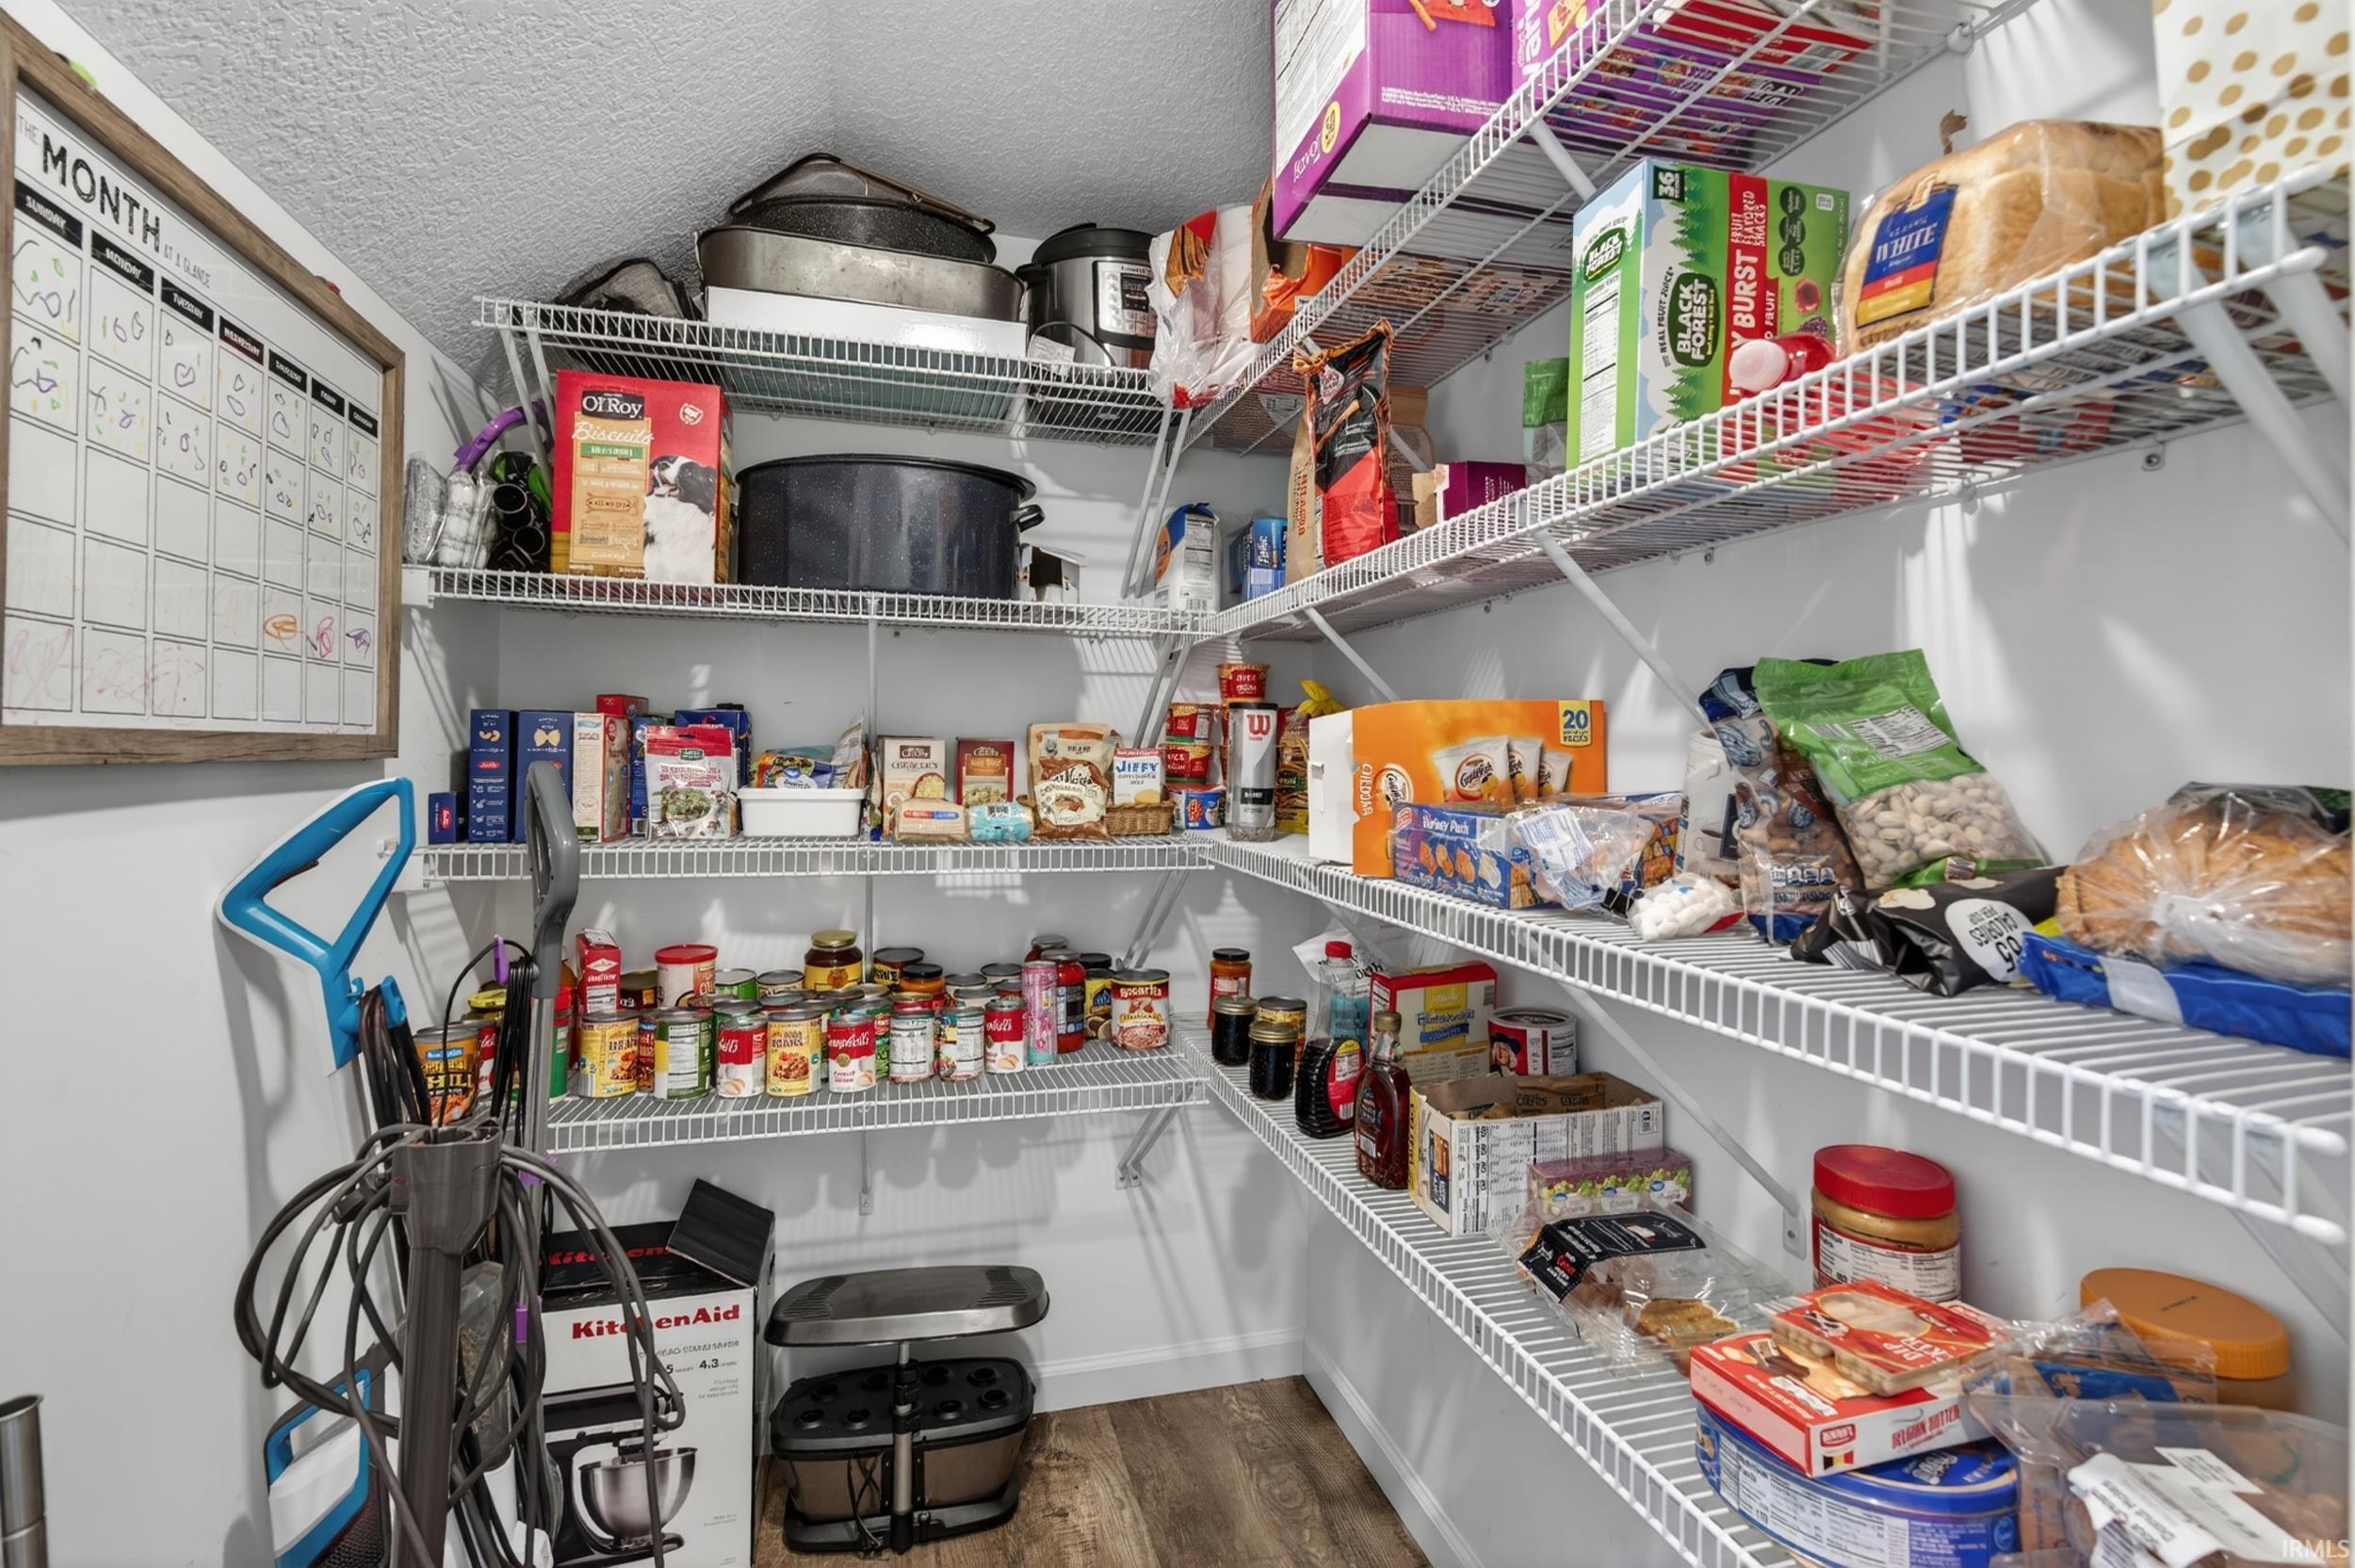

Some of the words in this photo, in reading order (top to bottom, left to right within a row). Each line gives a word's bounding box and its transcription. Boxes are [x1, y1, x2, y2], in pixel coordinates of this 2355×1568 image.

[42, 134, 160, 252] MONTH
[1658, 170, 1676, 197] 36
[25, 194, 68, 230] SUNDAY
[1730, 212, 1743, 244] FRUIT
[1742, 190, 1756, 246] FLAVORED
[1753, 204, 1766, 247] SNACKS
[1876, 222, 1939, 264] WHITE
[1732, 250, 1760, 329] BURST
[1657, 299, 1666, 329] FRUIT
[1677, 283, 1694, 353] BLACK
[1690, 278, 1708, 360] FOREST
[1764, 290, 1776, 327] FRUIT
[1657, 328, 1668, 354] REAL
[571, 421, 655, 445] Biscuits
[1563, 709, 1589, 730] 20
[1115, 760, 1160, 772] JIFFY
[1361, 763, 1373, 816] CHEDDAR
[1968, 912, 2018, 947] CALORIES
[699, 1358, 720, 1370] 4.3
